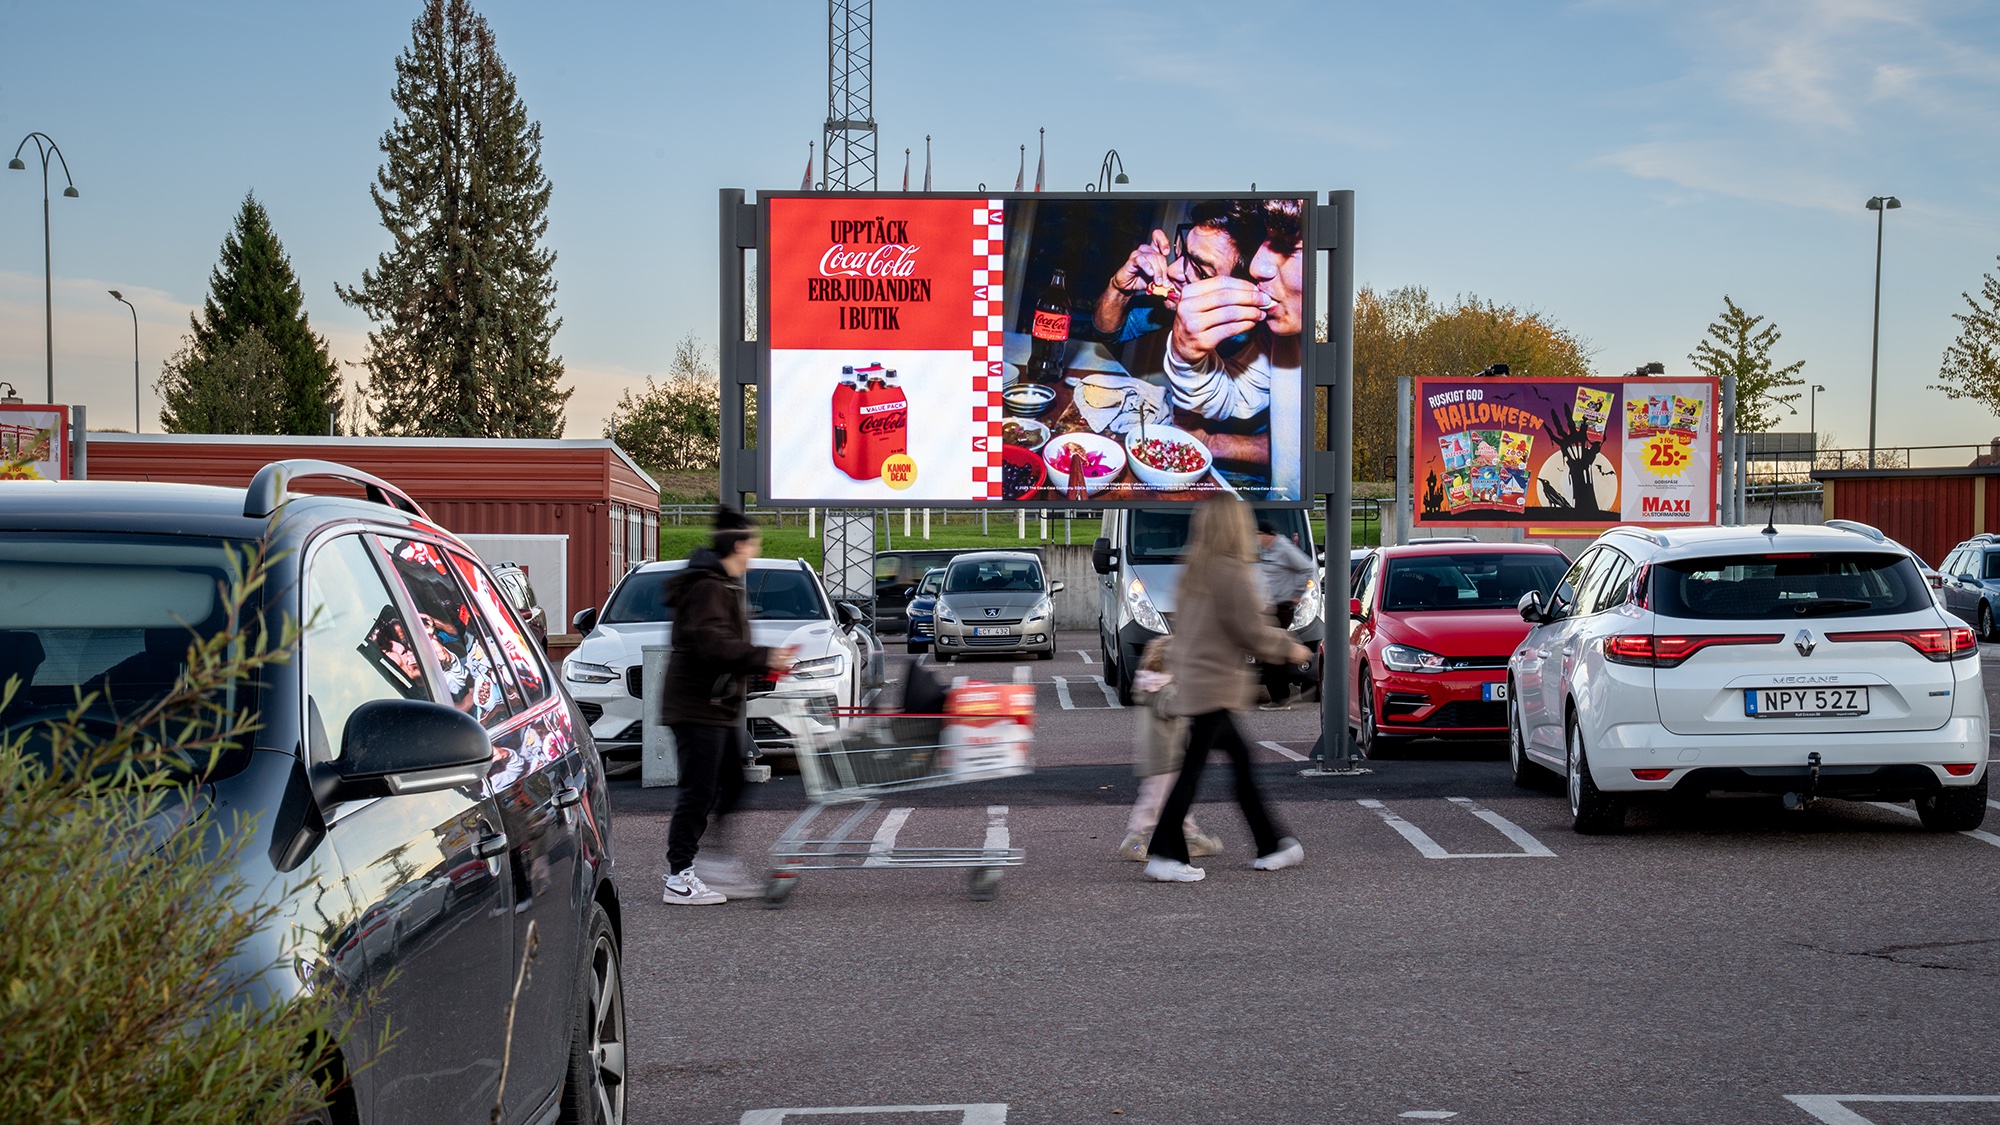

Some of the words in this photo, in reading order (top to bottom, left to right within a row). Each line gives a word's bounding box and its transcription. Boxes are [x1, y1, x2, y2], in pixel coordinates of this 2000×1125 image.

[830, 216, 908, 244] UPPTÄCK
[808, 278, 931, 302] ERBJUDANDEN
[839, 306, 846, 330] I
[849, 306, 900, 330] BUTIK
[1428, 390, 1464, 408] RUSKIGT
[1466, 389, 1484, 400] GOD
[1433, 402, 1544, 433] HALLOWEEN
[1650, 444, 1687, 466] 25:-
[887, 464, 911, 472] KANON
[891, 473, 908, 481] DEAL
[1642, 496, 1690, 512] MAXI
[1766, 691, 1807, 710] NPY
[1815, 690, 1858, 709] 52Z
